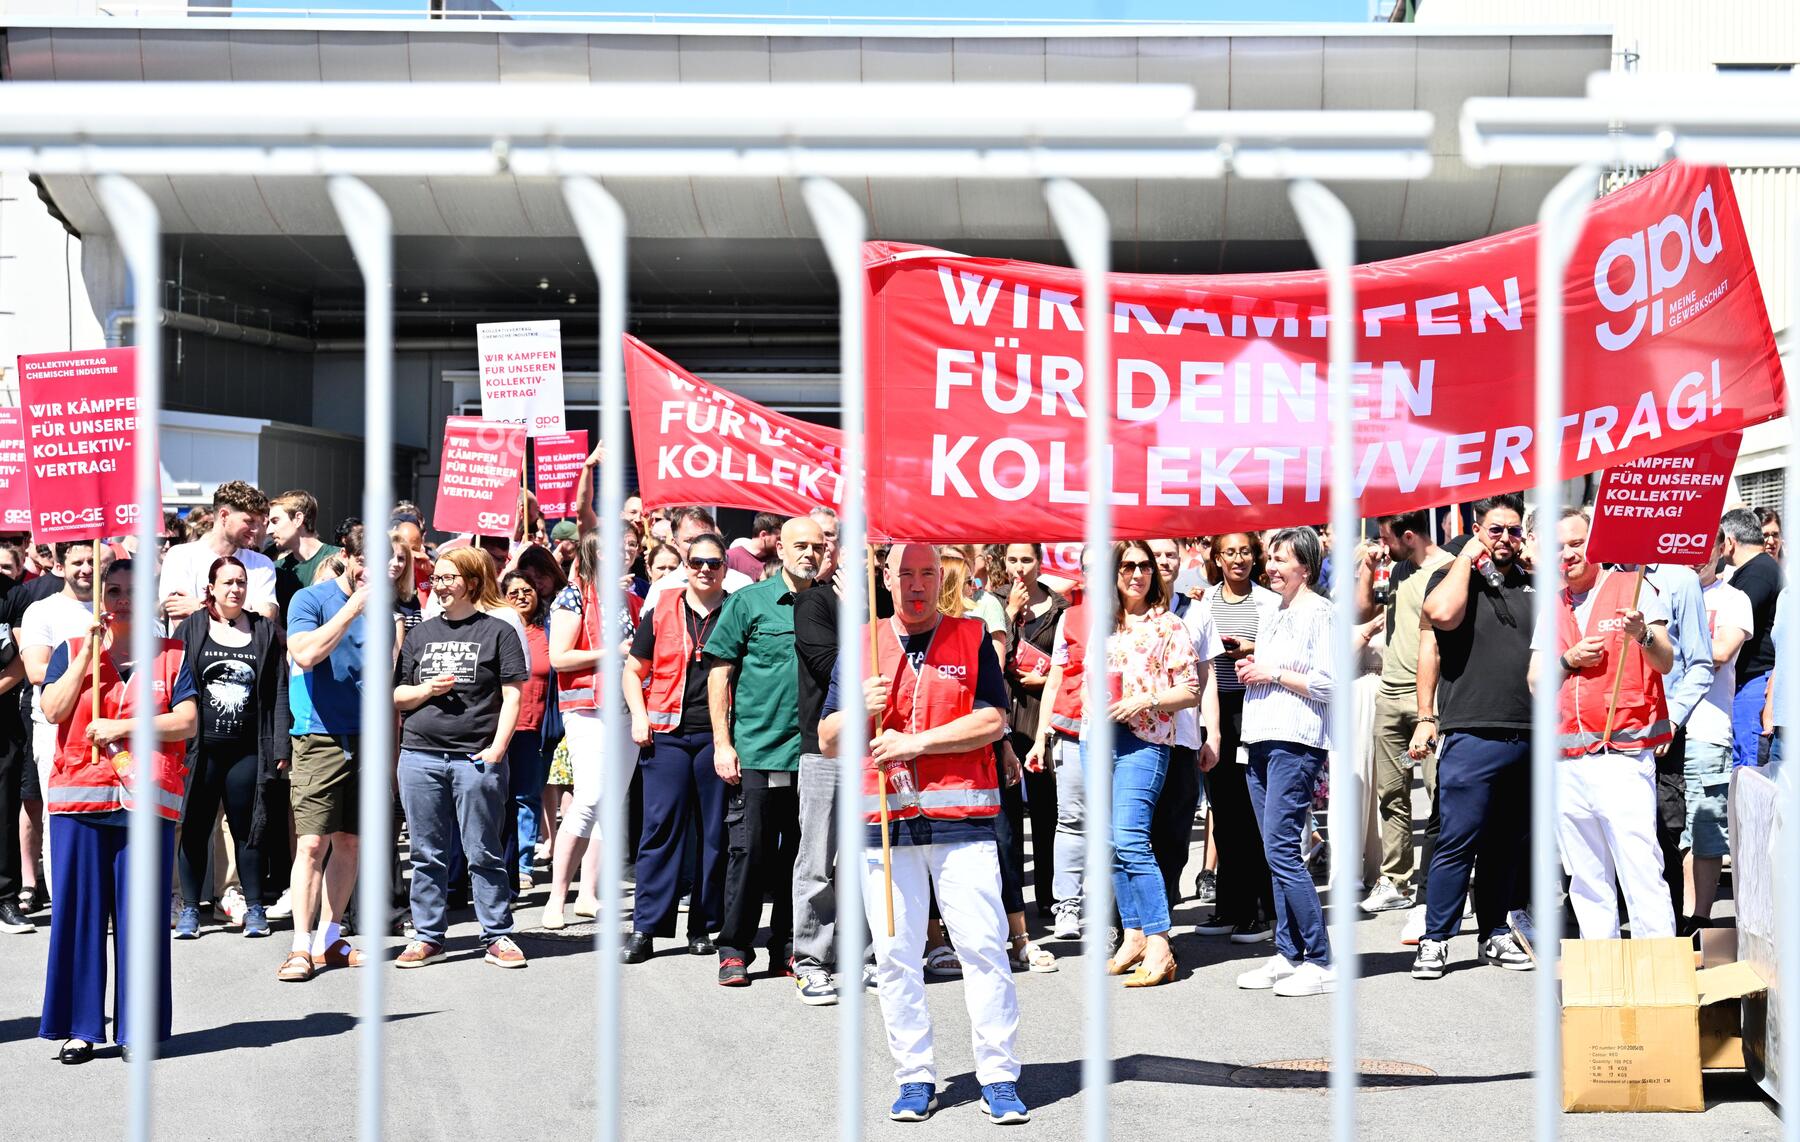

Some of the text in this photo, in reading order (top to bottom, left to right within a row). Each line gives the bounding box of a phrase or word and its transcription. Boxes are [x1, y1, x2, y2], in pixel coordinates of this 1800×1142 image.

[1594, 184, 1722, 351] gpa
[1669, 291, 1696, 314] MEINE
[1669, 279, 1729, 327] GEWERKSCHAFT
[25, 358, 107, 370] KOLLEKTIVVERTRAG
[484, 354, 504, 362] WIR
[26, 366, 119, 380] CHEMISCHE INDUSTRIE
[508, 363, 556, 374] UNSEREN
[486, 376, 546, 387] KOLLEKTIV-
[935, 337, 1088, 418] FÜR
[1117, 358, 1435, 424] DEINEN
[487, 389, 537, 399] VERTRAG!
[29, 403, 63, 418] WIR
[660, 396, 746, 439] FÜR
[31, 421, 66, 438] FÜR
[33, 438, 132, 458] KOLLEKTIV-
[449, 437, 470, 447] WIR
[447, 449, 498, 463] KÄMPFEN
[34, 458, 117, 478] VERTRAG!
[446, 461, 518, 477] FÜR UNSEREN
[444, 474, 505, 488] KOLLEKTIV-
[1609, 472, 1725, 486] FÜR UNSEREN
[442, 486, 493, 500] VERTRAG!
[1606, 489, 1703, 502] KOLLEKTIV-
[115, 503, 142, 525] gp
[1603, 505, 1683, 518] VERTRAG!
[477, 511, 510, 529] gpa
[1656, 532, 1708, 555] gpa
[937, 664, 967, 680] gpa
